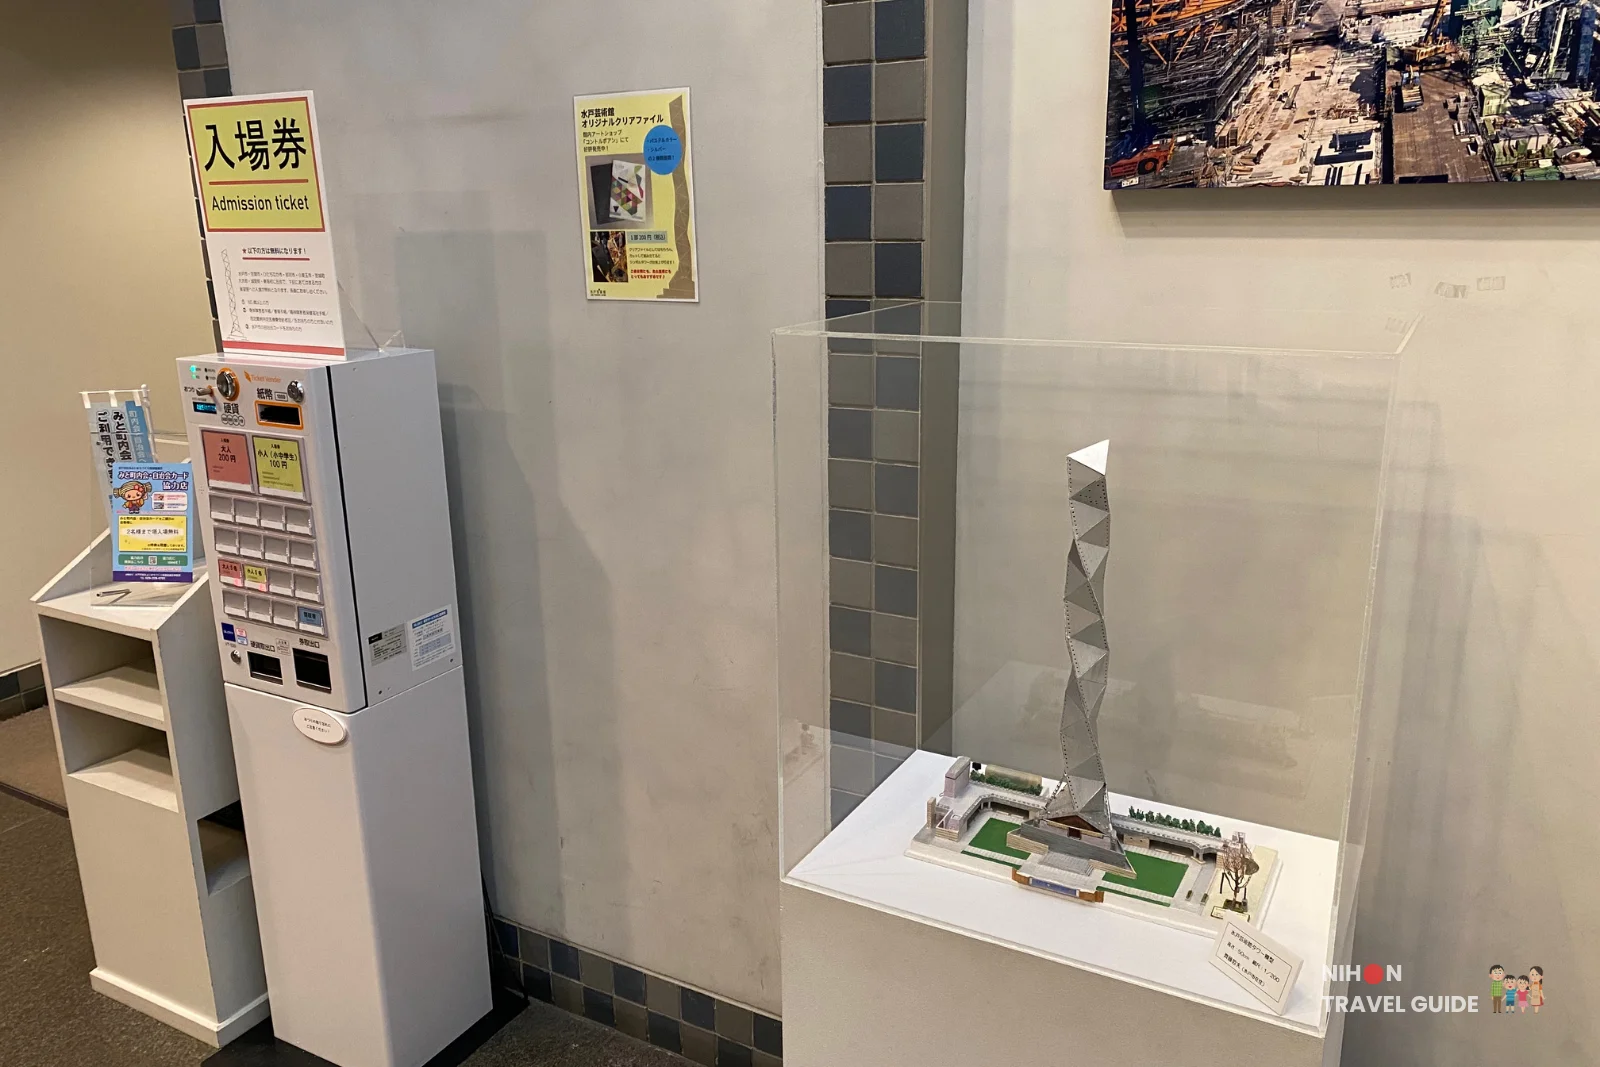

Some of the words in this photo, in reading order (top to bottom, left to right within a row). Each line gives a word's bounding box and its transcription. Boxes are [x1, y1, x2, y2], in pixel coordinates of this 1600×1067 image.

[580, 107, 615, 119] 水戸芸術館
[581, 114, 664, 129] オリジナルクリアファイル
[204, 117, 306, 172] 入場券
[212, 195, 272, 211] Admission
[275, 195, 309, 210] ticket
[256, 388, 273, 400] 紙幣
[224, 402, 240, 415] 硬貨
[220, 446, 232, 454] 大人
[258, 450, 298, 462] 小人（小中学生）
[118, 471, 189, 480] みと町内会・自治会カード
[162, 480, 188, 490] 協力店
